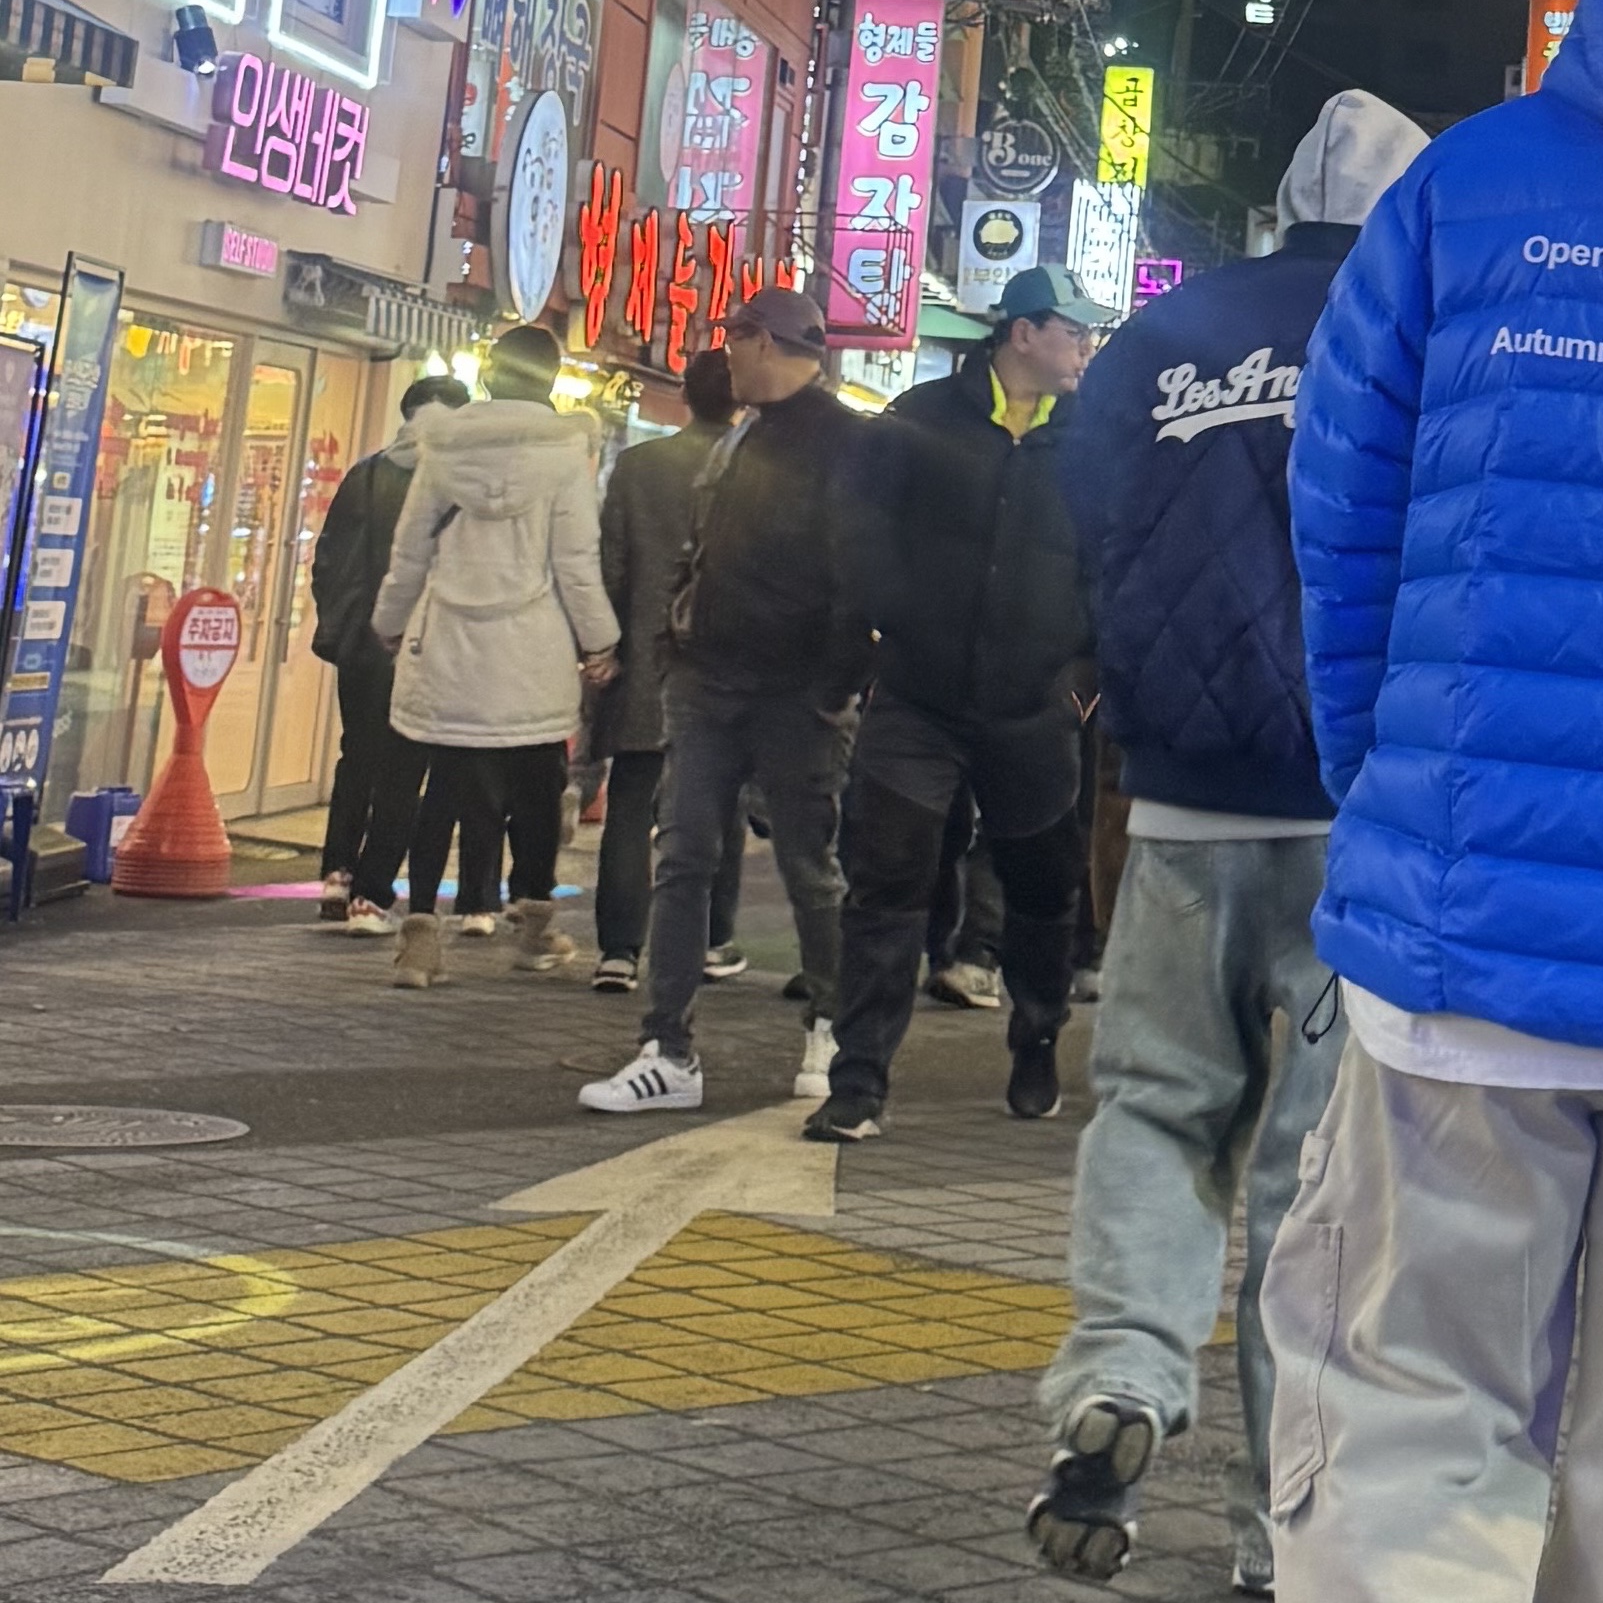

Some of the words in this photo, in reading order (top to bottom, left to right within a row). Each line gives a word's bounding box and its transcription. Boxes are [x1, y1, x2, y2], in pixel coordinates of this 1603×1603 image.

[857, 12, 939, 64] 형제들
[221, 52, 370, 217] 인생네컷
[848, 79, 932, 327] 감자탕
[1220, 346, 1302, 408] An
